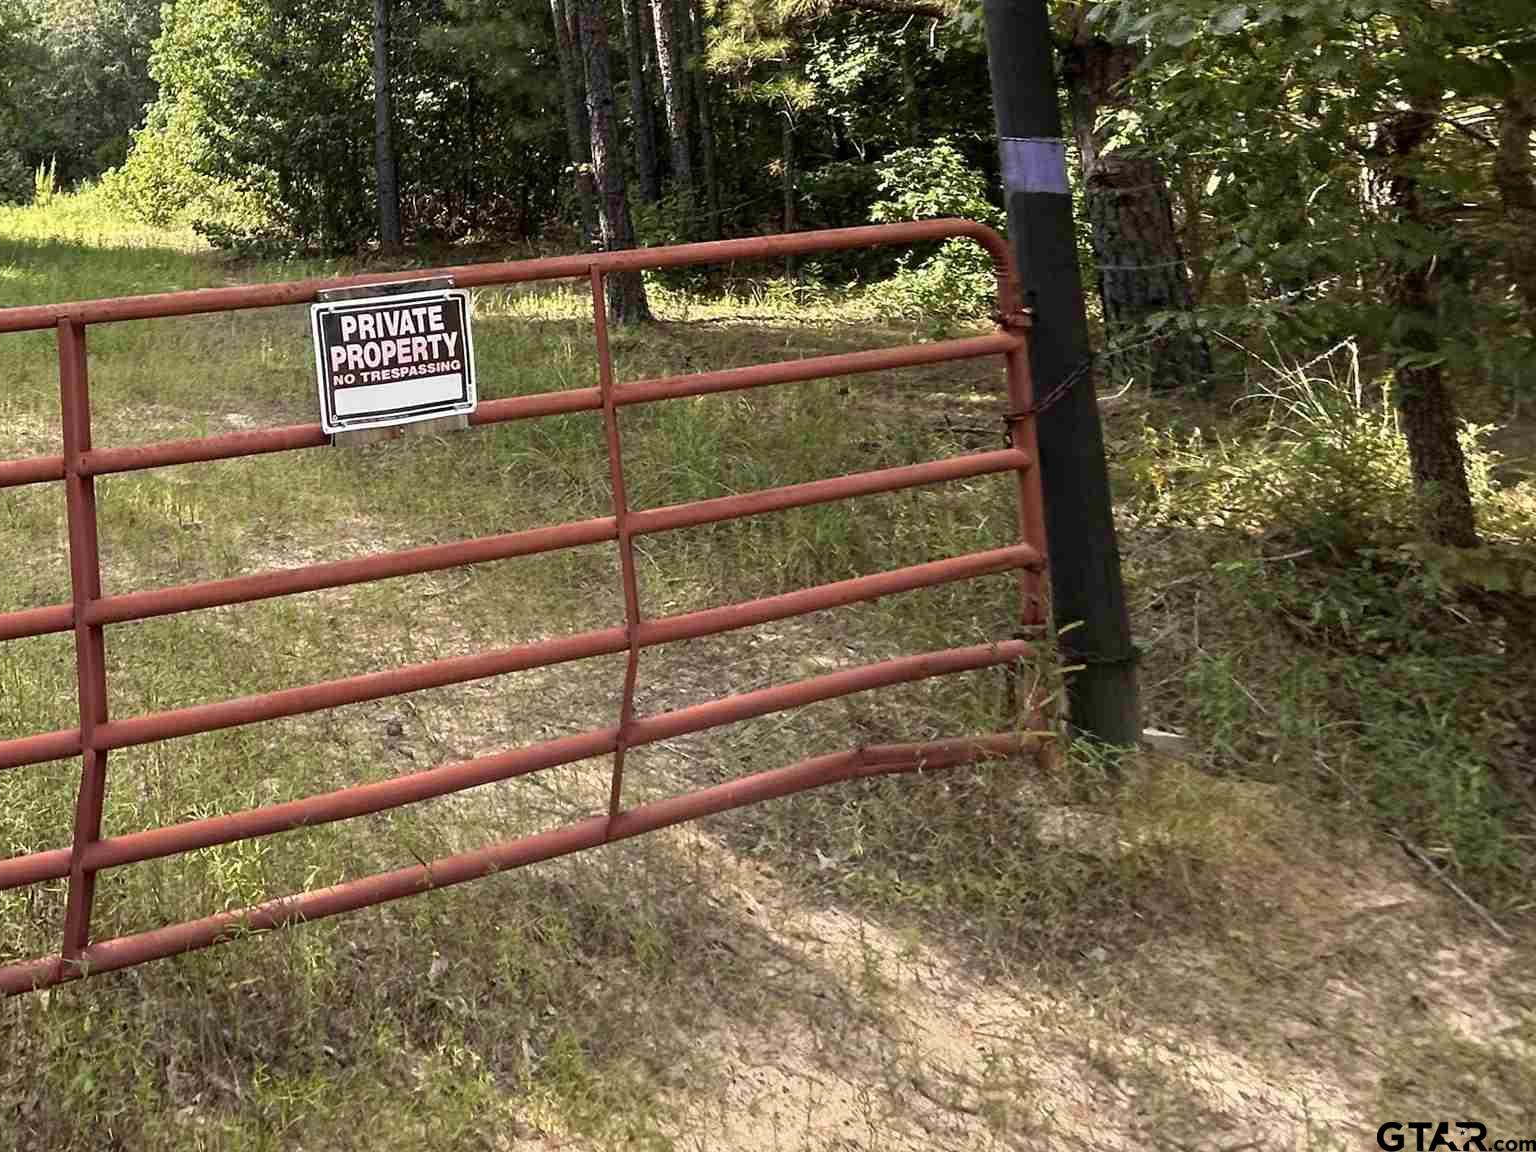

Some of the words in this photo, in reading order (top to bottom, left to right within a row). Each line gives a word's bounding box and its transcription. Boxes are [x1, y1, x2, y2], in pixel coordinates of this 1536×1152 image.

[340, 305, 445, 342] PRIVATE
[330, 331, 458, 372] PROPERTY
[333, 373, 356, 386] NO
[360, 360, 462, 383] TRESPASSING
